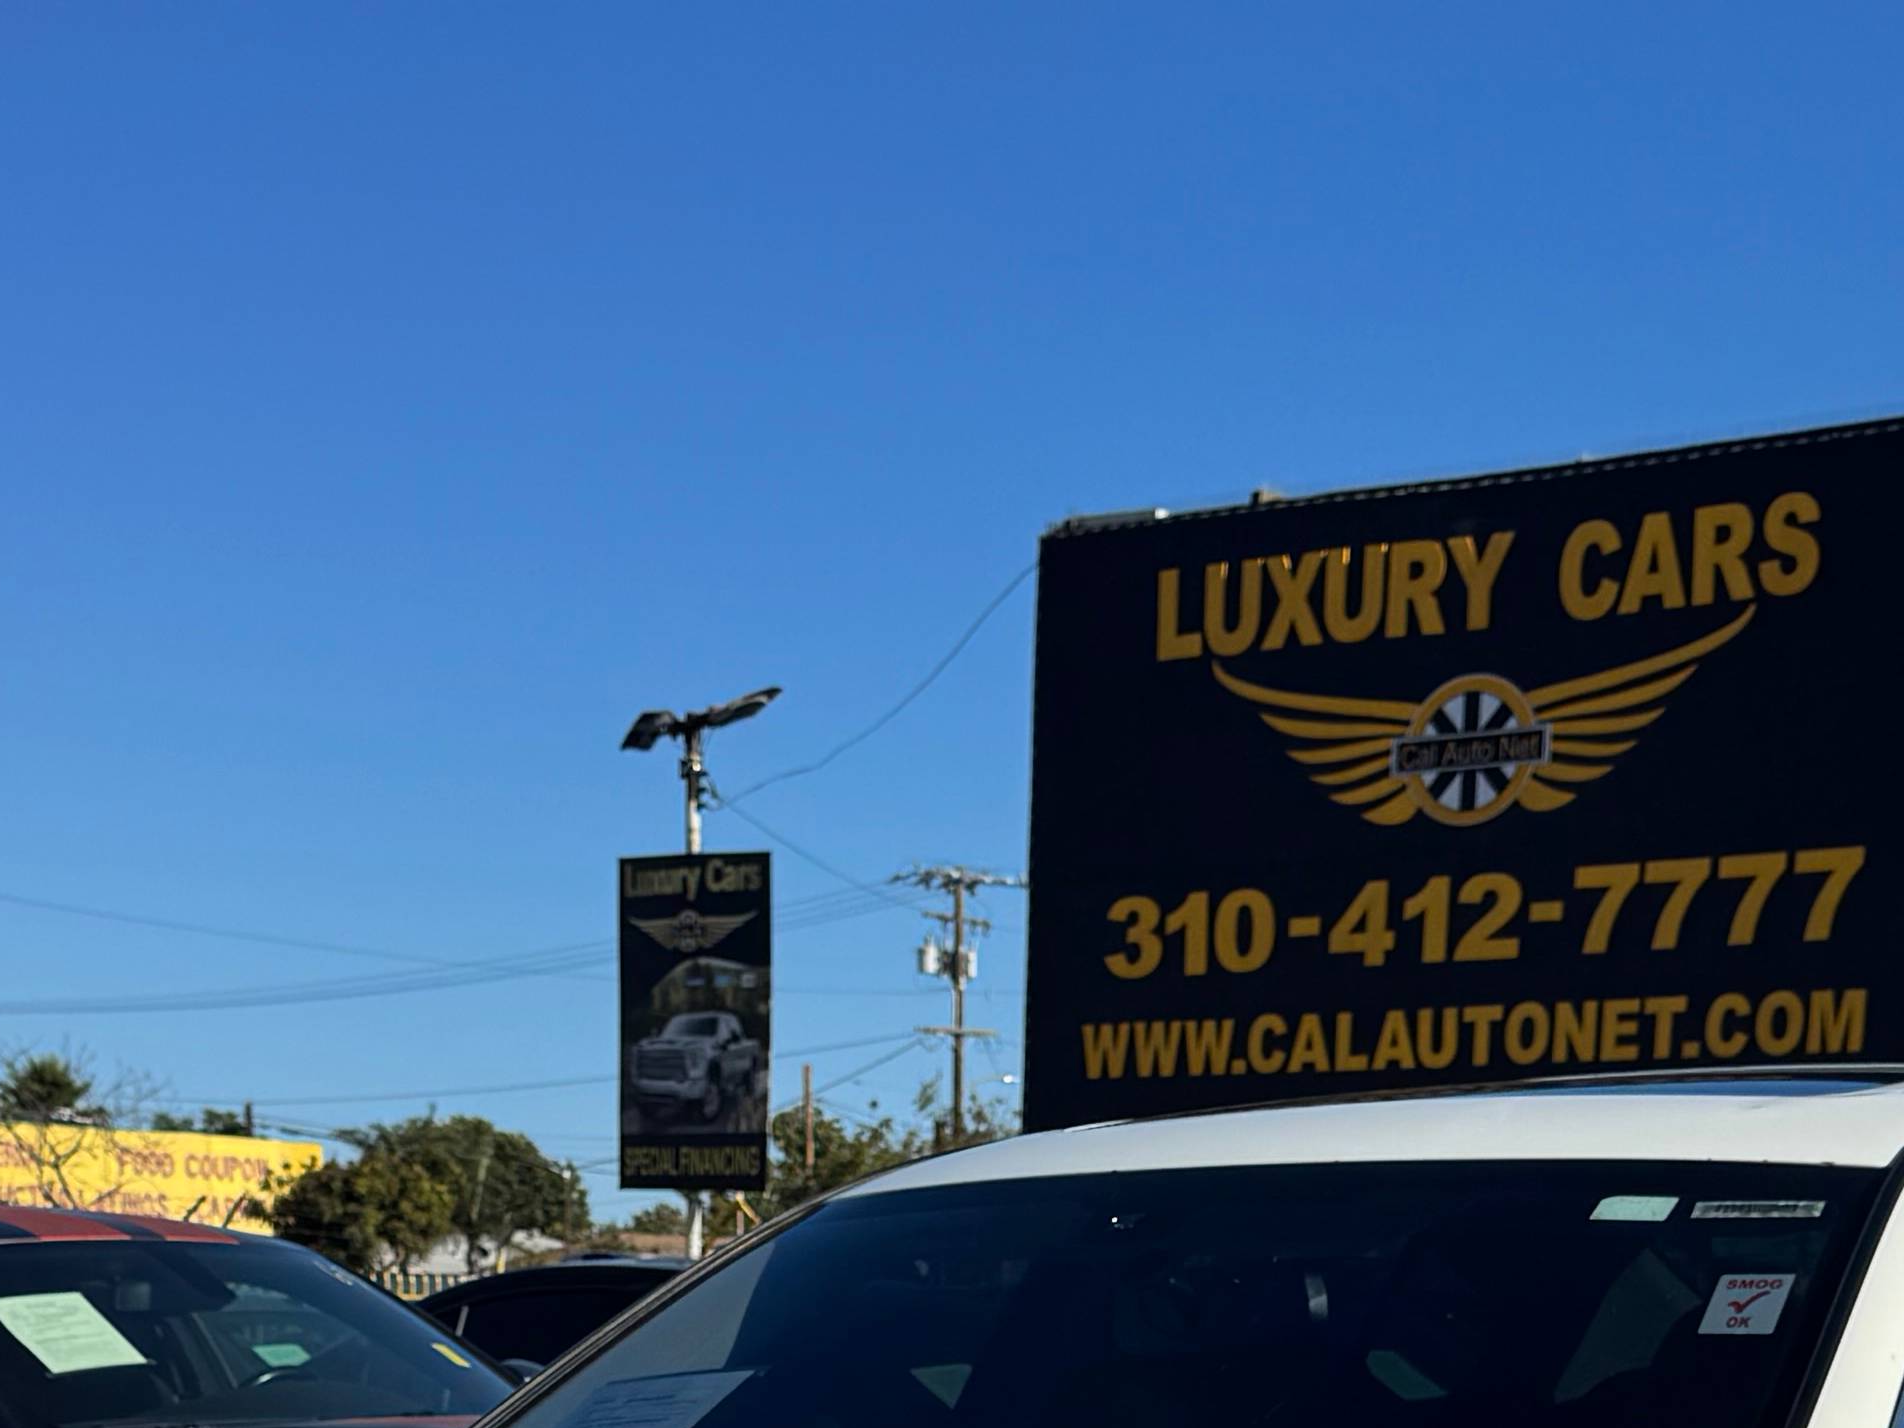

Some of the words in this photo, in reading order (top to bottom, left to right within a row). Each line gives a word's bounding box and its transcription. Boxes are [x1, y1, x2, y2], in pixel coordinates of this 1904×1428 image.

[1155, 529, 1516, 662] LUXURY
[1558, 491, 1821, 622] CARS
[704, 858, 762, 893] Cars
[1104, 845, 1866, 979] 310-412-7777
[1081, 987, 1868, 1080] WWW.CALAUTONET.COM
[1726, 1279, 1784, 1291] SMOG
[1726, 1316, 1753, 1329] OK
